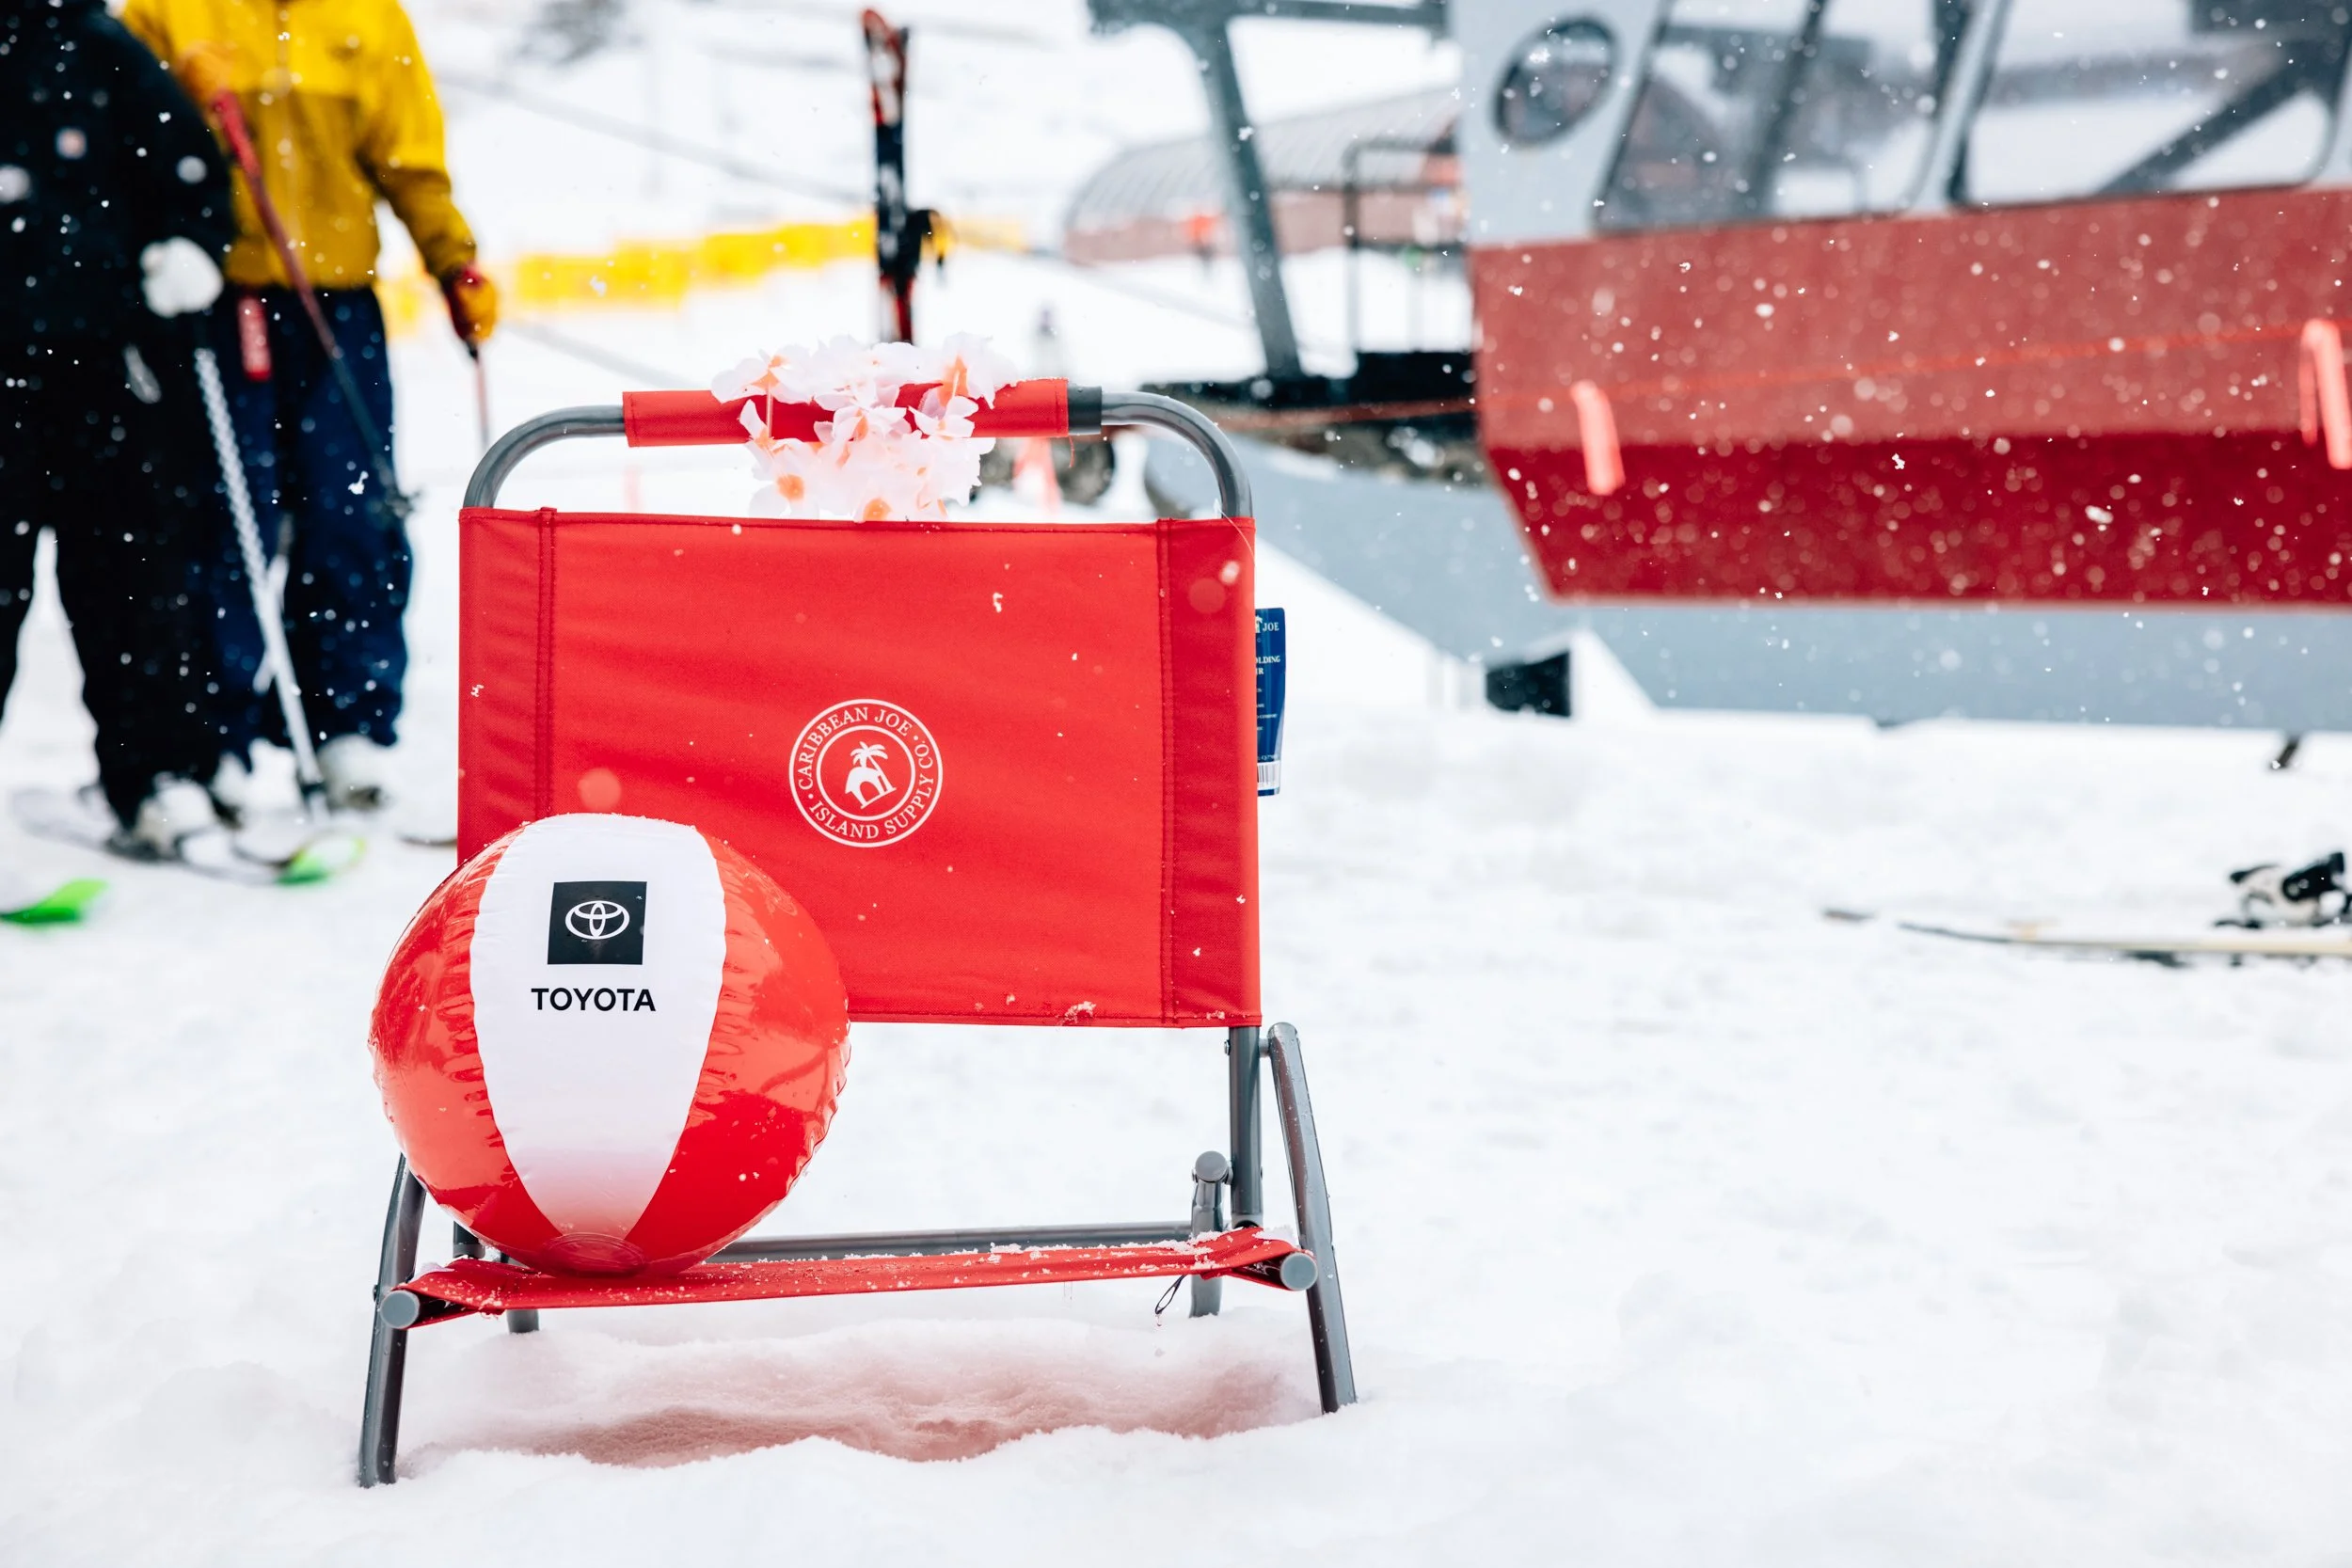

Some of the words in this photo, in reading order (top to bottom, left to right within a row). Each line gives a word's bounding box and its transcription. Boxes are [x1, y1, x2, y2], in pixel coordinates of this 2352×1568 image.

[1262, 622, 1279, 631] JOE
[798, 707, 868, 790] CARIBBEAN
[874, 709, 913, 736] JOE
[809, 800, 880, 838] ISLAND
[883, 774, 934, 834] SUPPLY
[531, 988, 657, 1011] TOYOTA
